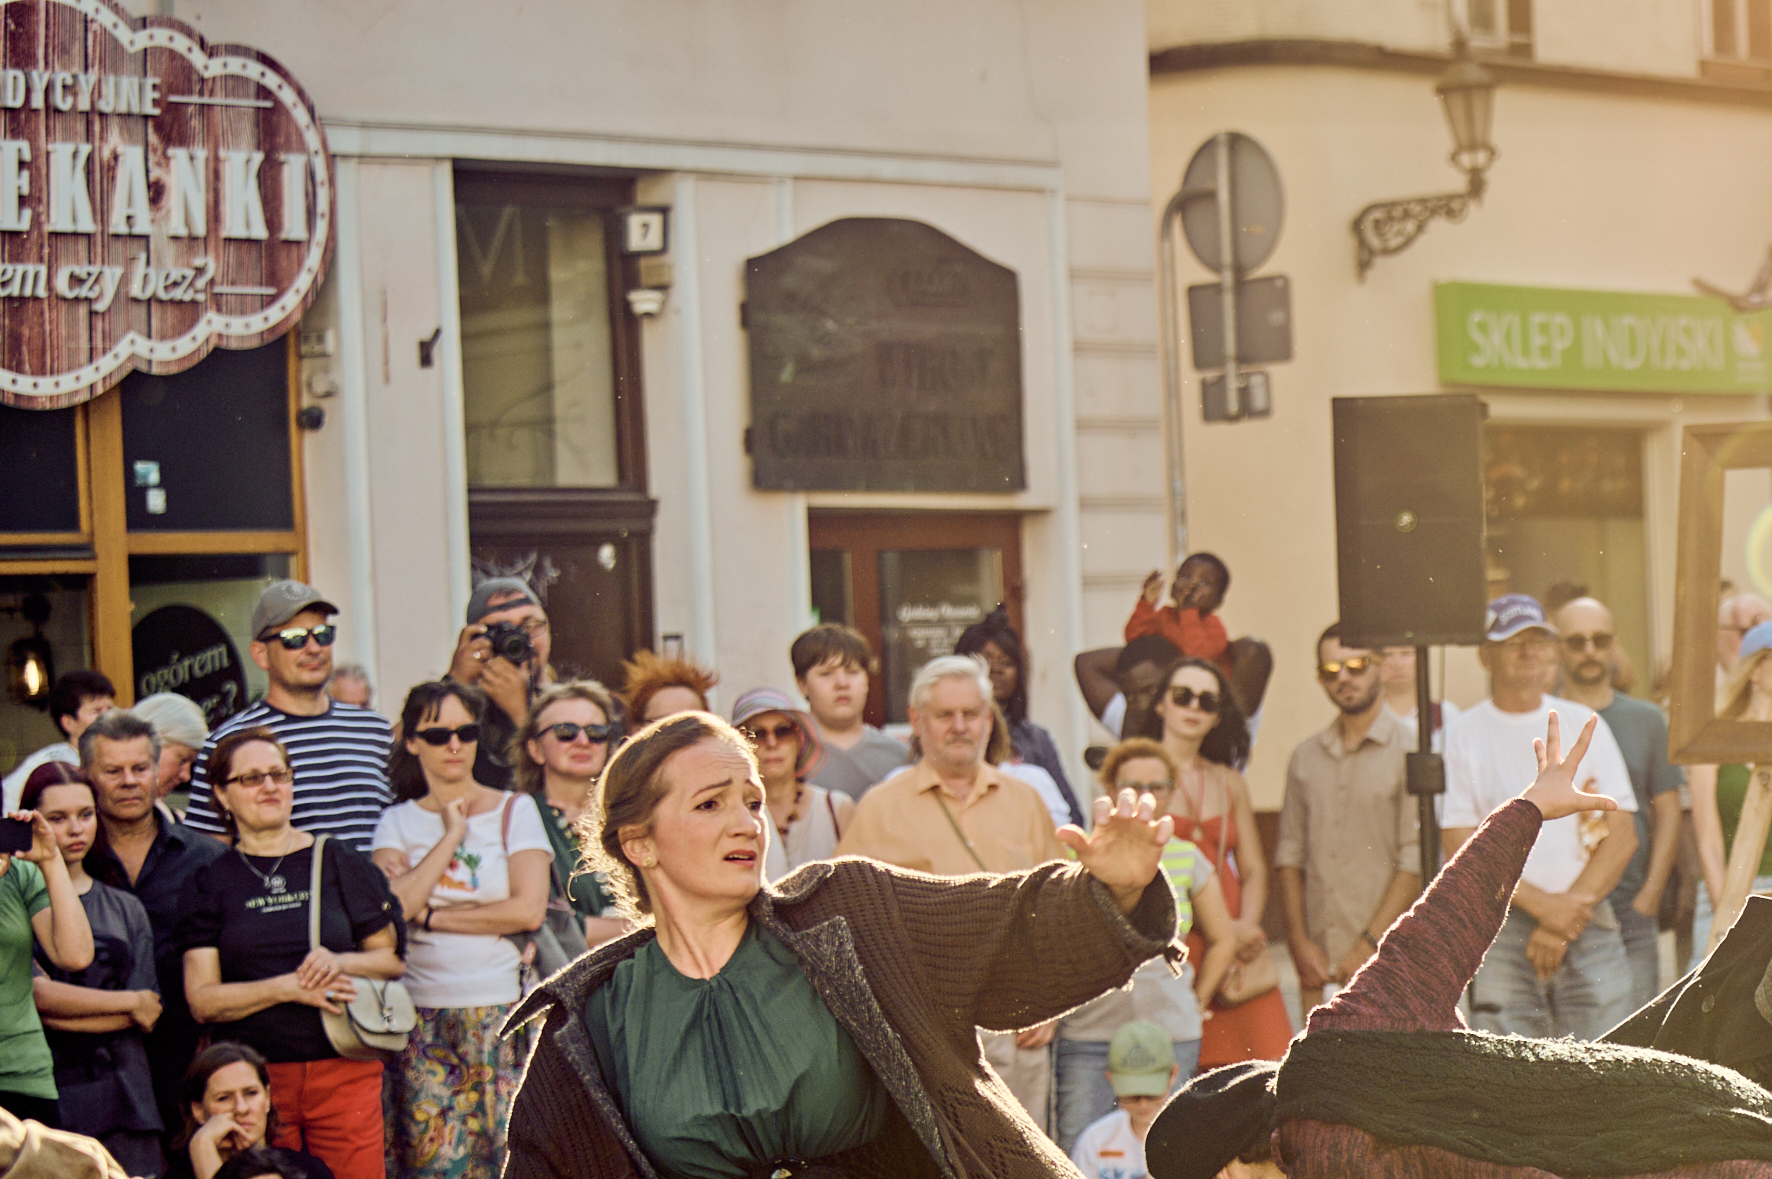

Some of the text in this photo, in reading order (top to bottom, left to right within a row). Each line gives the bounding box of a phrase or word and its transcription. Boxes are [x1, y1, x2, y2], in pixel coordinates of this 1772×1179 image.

[0, 140, 309, 241] EKANKI
[57, 264, 124, 313] czy
[130, 252, 215, 302] bez?
[1468, 311, 1574, 367] SKLEP
